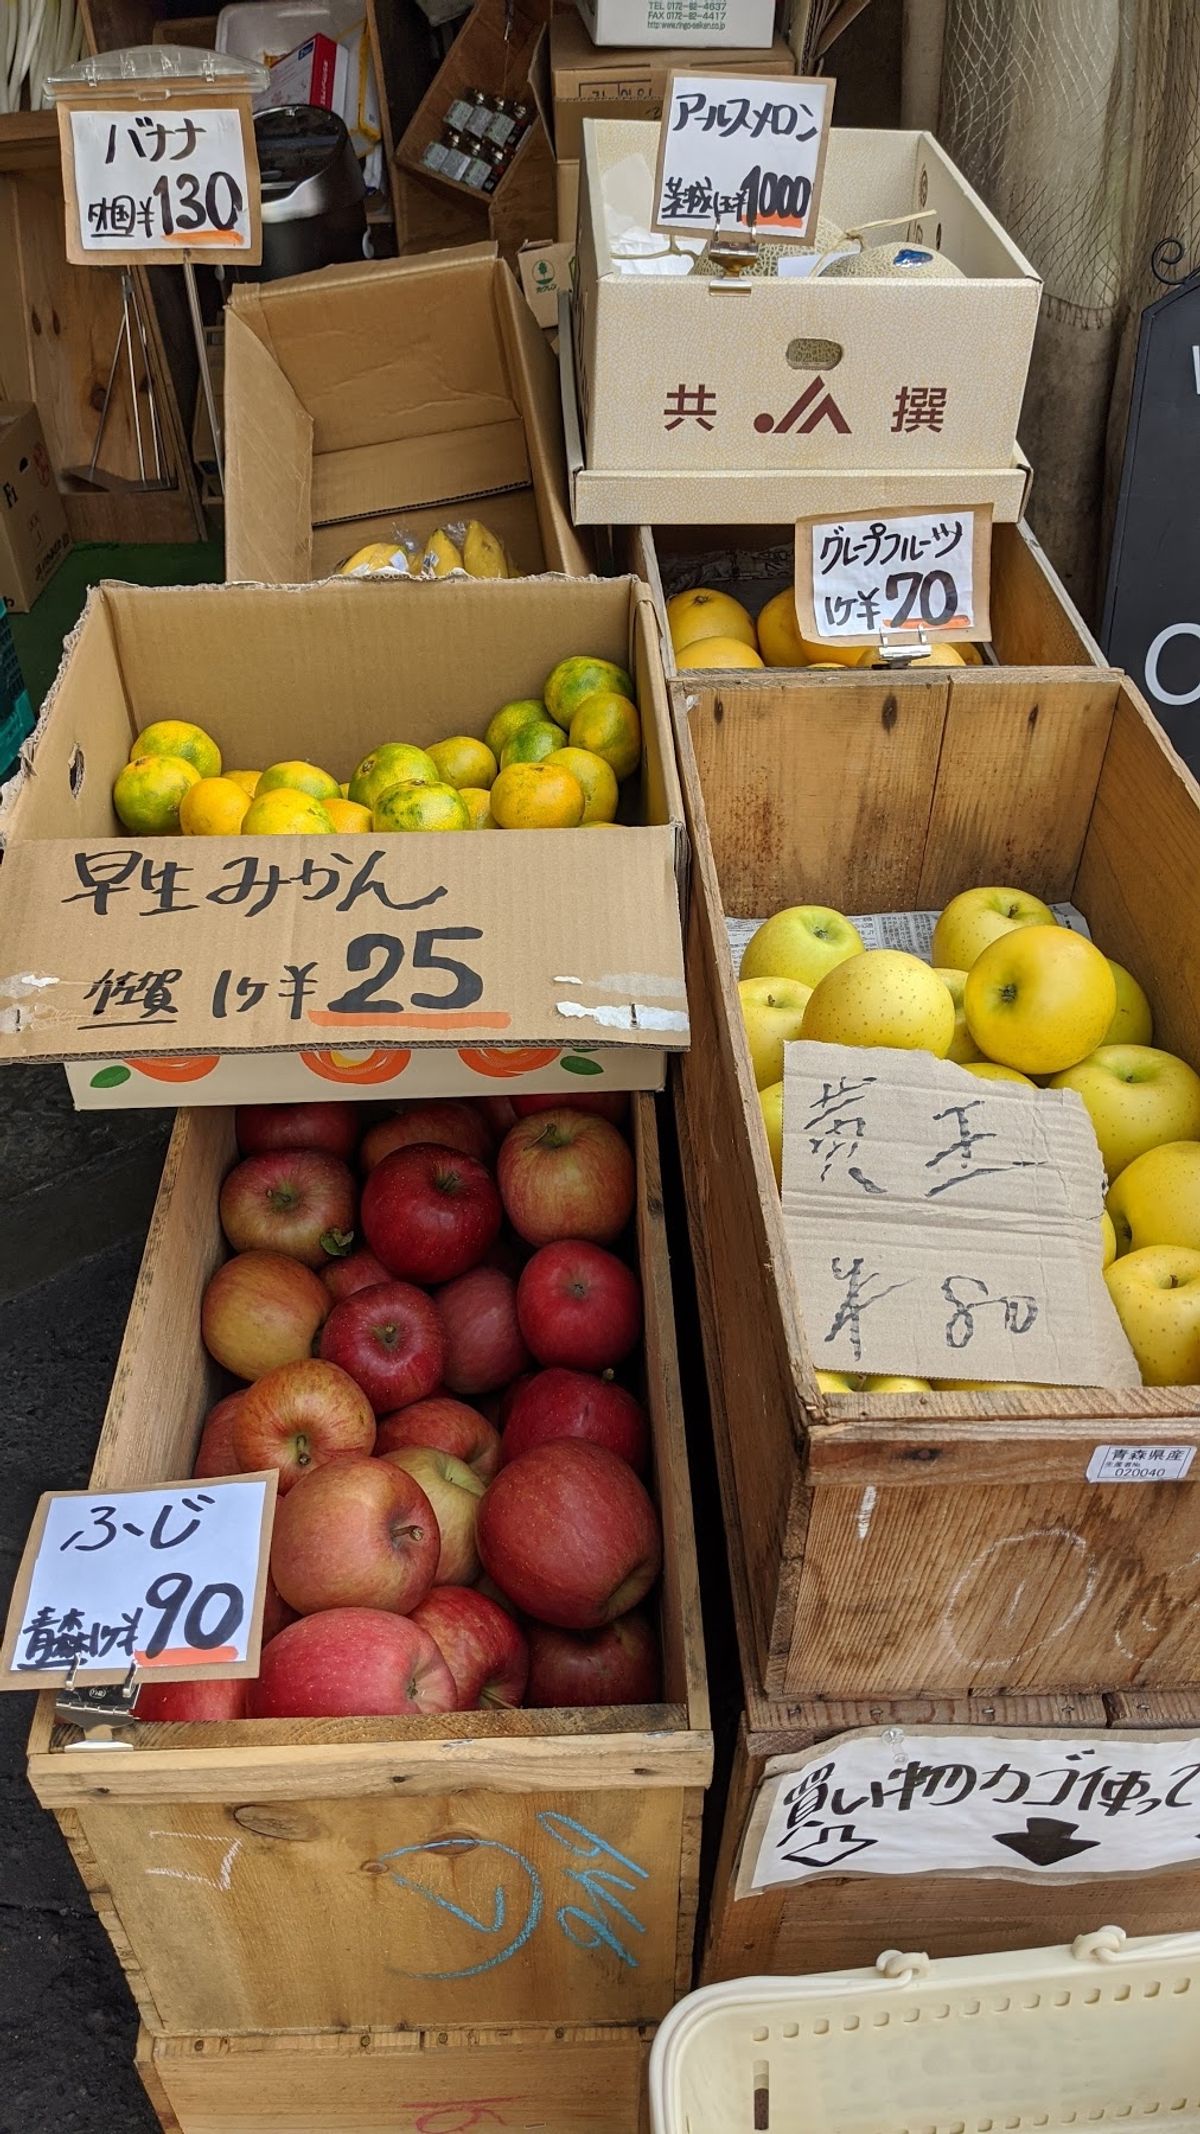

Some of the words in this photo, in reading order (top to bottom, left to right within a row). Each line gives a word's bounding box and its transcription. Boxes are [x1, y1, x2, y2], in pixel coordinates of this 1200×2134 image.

[648, 1, 665, 11] TEL
[648, 11, 665, 21] FAX
[105, 117, 207, 164] バナナ
[672, 93, 818, 142] アールスメロン
[664, 384, 717, 431] 共
[891, 386, 947, 432] 撰
[820, 521, 963, 575] グレープフルーツ
[1112, 1449, 1184, 1461] 青森県産
[1114, 1468, 1166, 1478] 020040
[60, 1494, 216, 1551] ふじ
